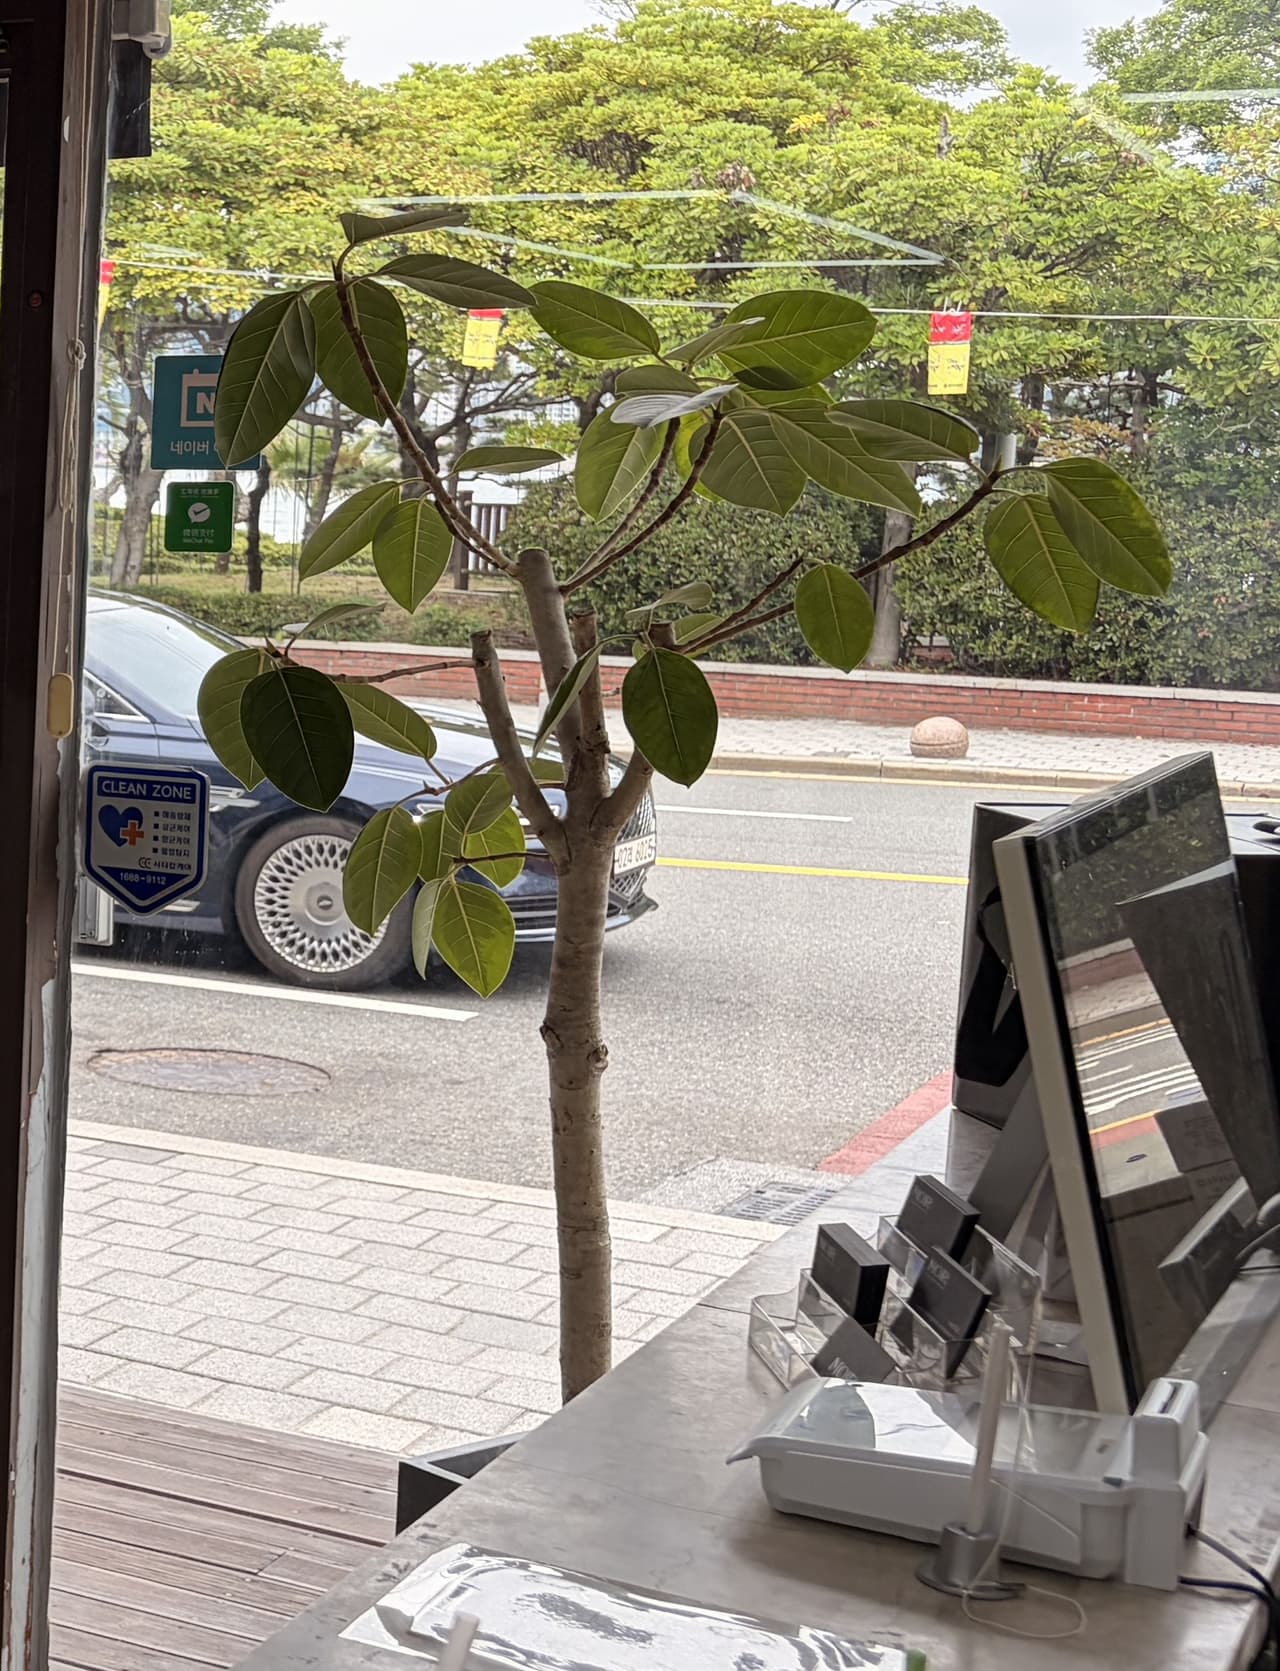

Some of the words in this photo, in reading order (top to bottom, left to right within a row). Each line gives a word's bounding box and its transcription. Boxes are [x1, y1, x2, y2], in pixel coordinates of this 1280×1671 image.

[170, 440, 209, 456] 네이버
[101, 780, 147, 797] CLEAN
[151, 784, 192, 800] ZONE
